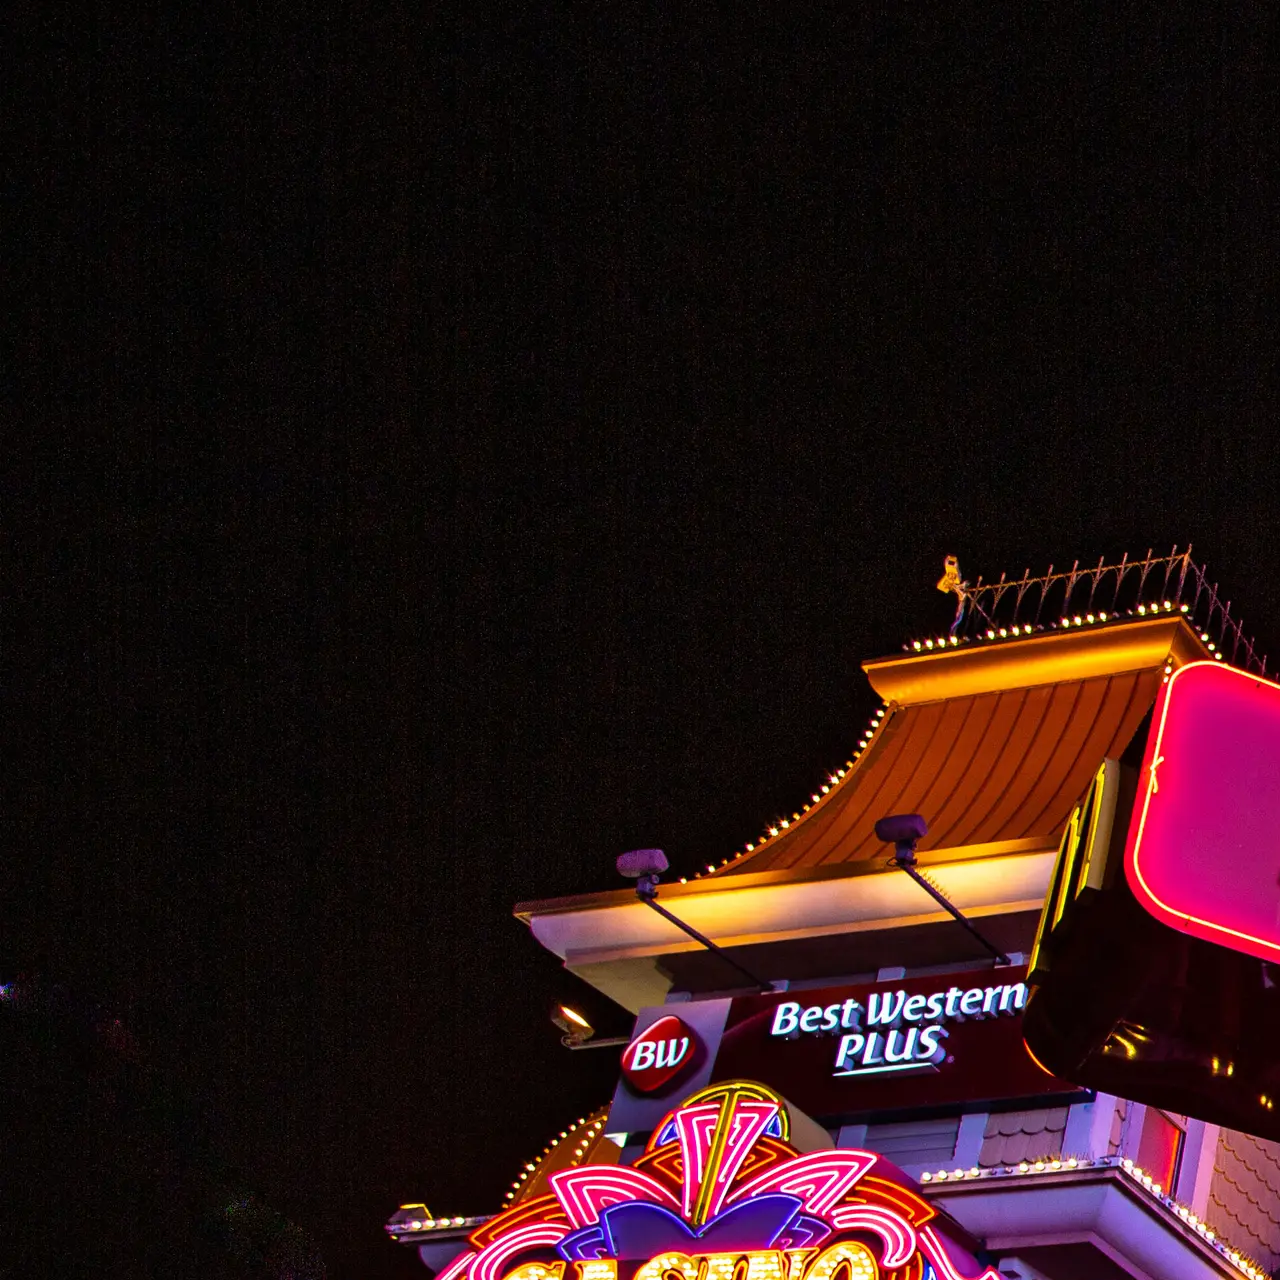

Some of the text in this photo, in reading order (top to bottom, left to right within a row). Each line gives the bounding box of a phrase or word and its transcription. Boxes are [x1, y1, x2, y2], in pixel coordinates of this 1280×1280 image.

[770, 981, 1026, 1037] Best Western
[630, 1034, 690, 1071] BW
[835, 1025, 947, 1067] PLUS
